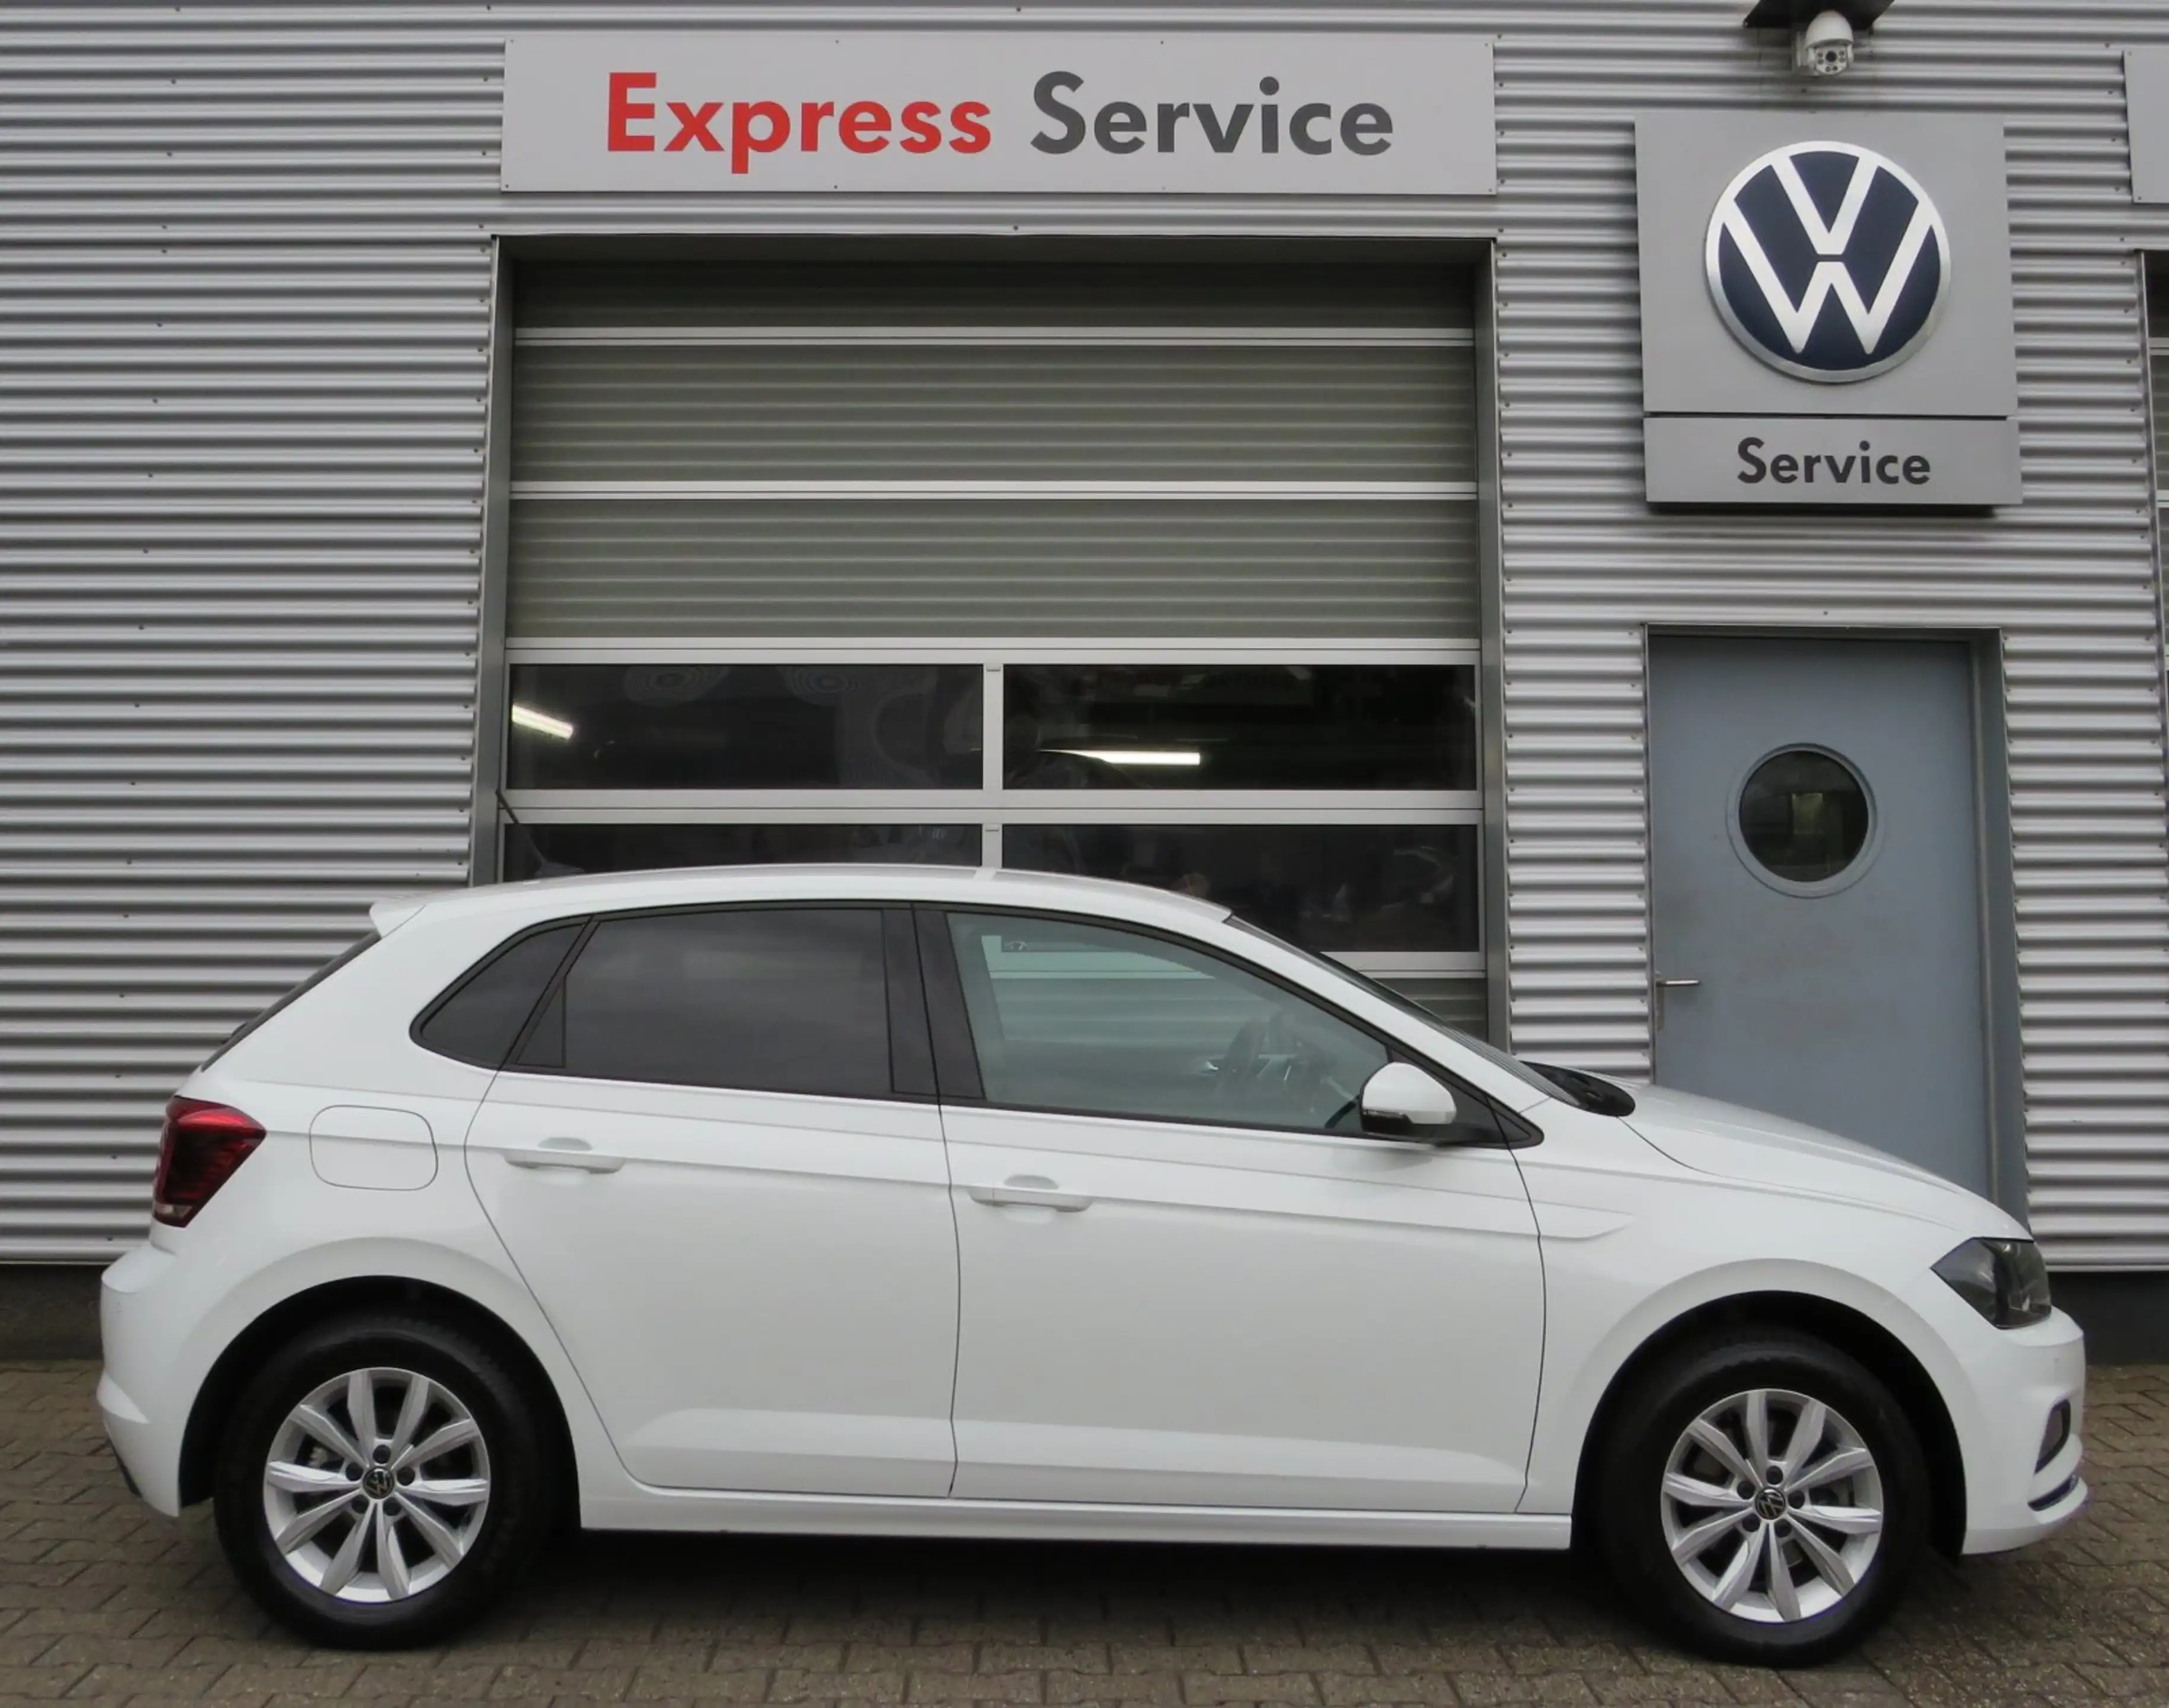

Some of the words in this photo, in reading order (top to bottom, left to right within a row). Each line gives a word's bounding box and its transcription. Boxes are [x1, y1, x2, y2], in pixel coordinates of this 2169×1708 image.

[608, 71, 992, 174] Express
[1030, 71, 1394, 157] Service
[1714, 148, 1943, 358] VW
[1737, 436, 1932, 485] Service
